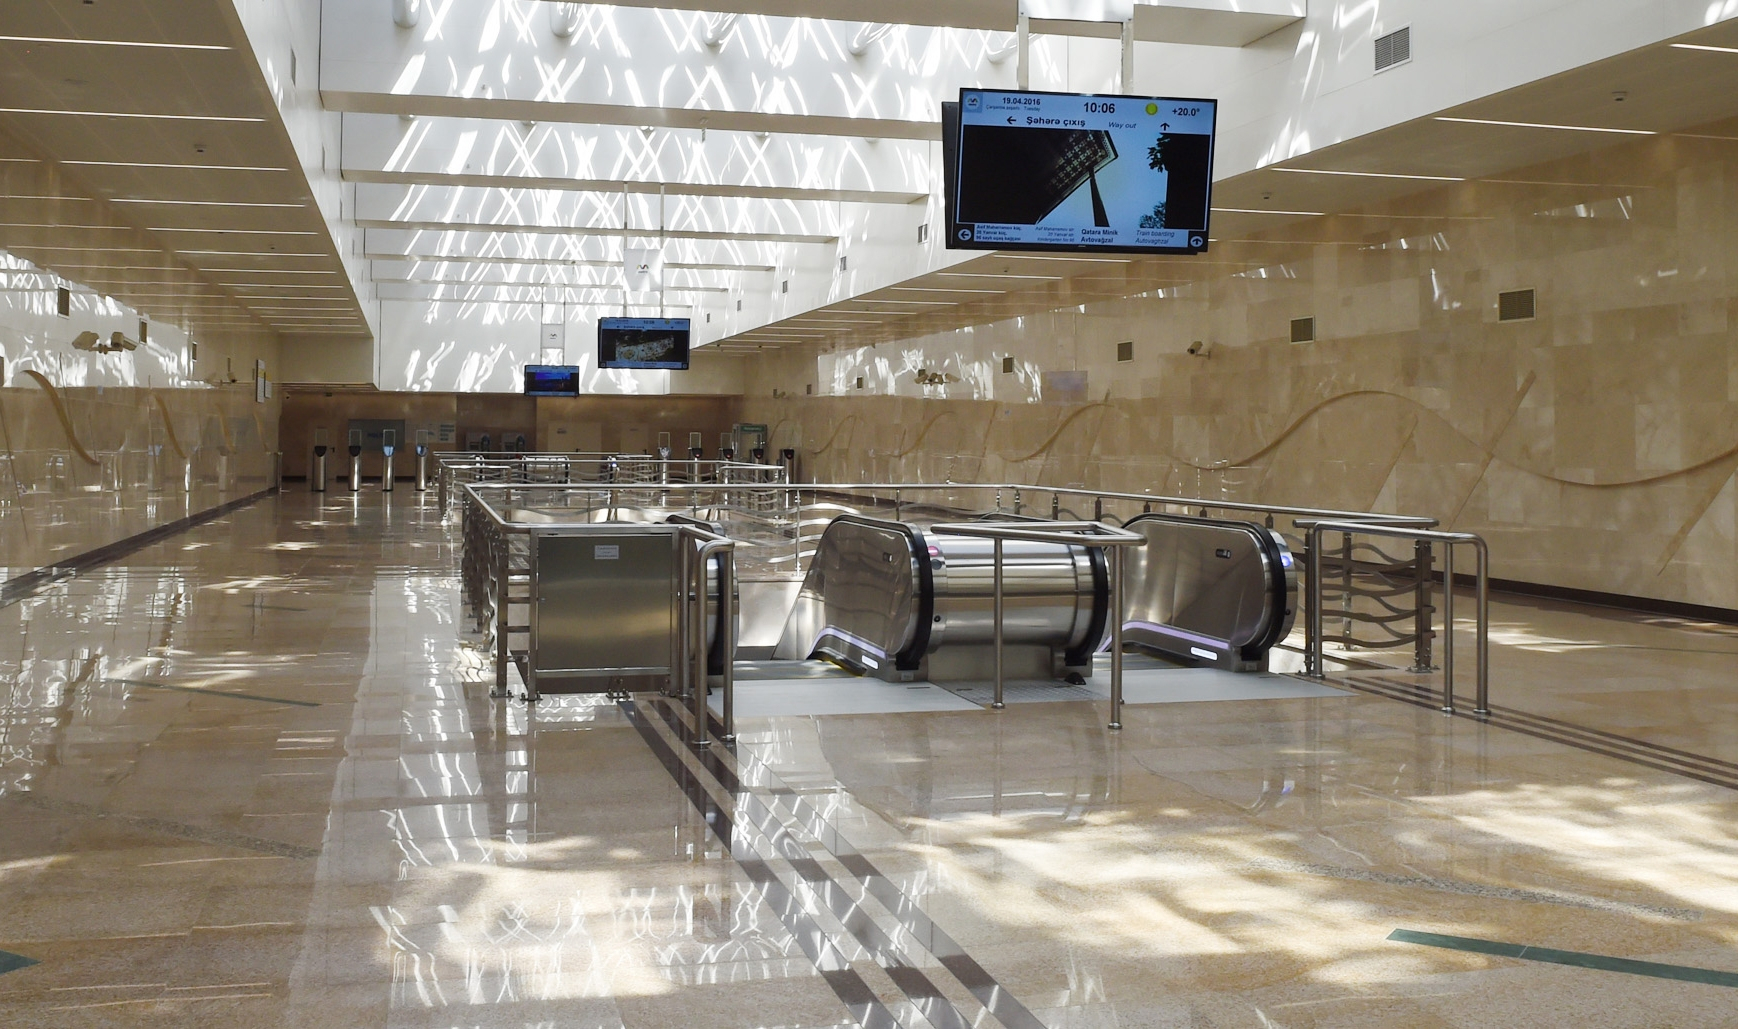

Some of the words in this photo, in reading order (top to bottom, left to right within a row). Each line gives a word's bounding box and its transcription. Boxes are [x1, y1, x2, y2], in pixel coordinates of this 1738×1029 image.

[1002, 97, 1040, 105] 19.04.2016
[1084, 102, 1116, 114] 10:06
[1172, 108, 1200, 116] +20.0°
[1026, 116, 1060, 125] Şəhərə
[1063, 118, 1086, 127] çıxış
[1108, 121, 1122, 129] Way
